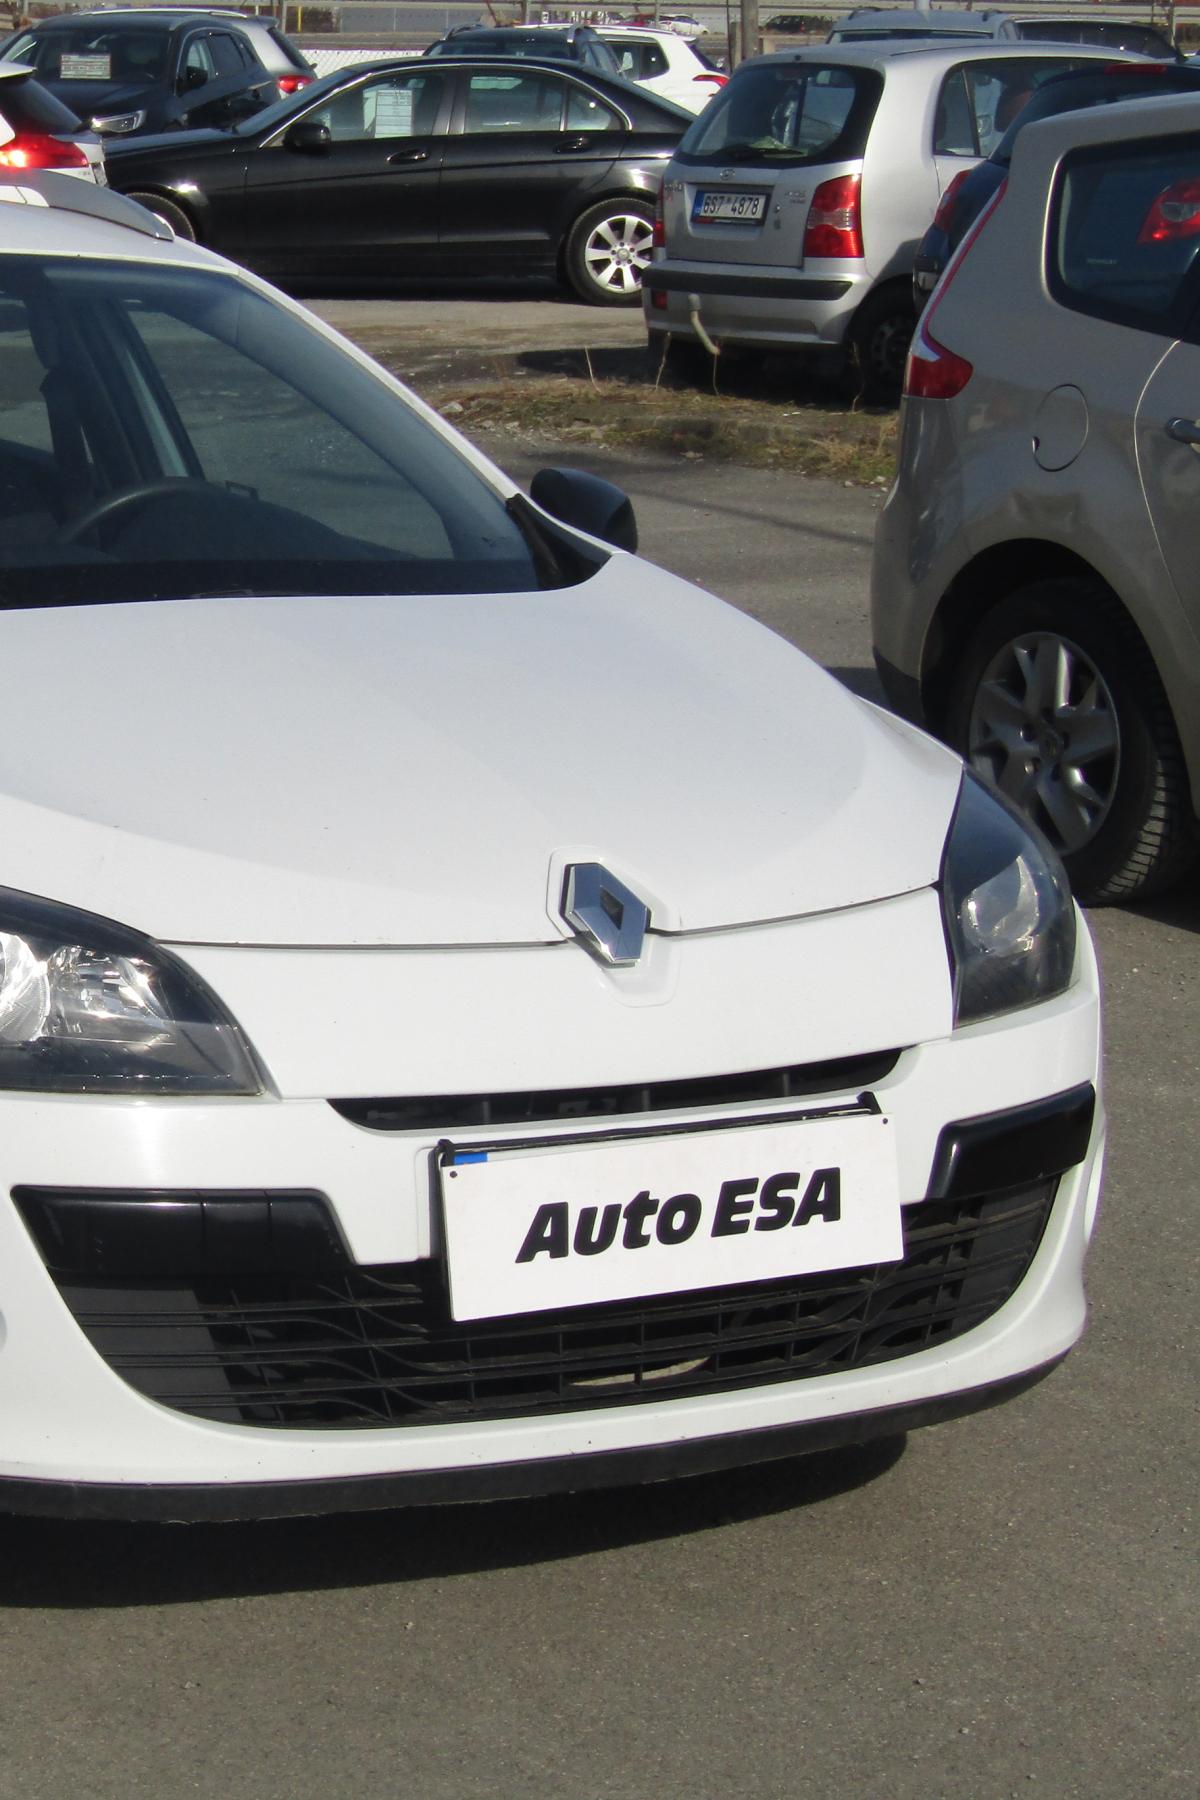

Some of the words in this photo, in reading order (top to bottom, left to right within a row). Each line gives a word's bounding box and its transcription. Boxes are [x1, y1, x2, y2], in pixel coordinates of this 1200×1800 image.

[731, 197, 760, 216] 4878
[514, 1190, 702, 1263] Auto
[710, 1167, 841, 1237] ESA
